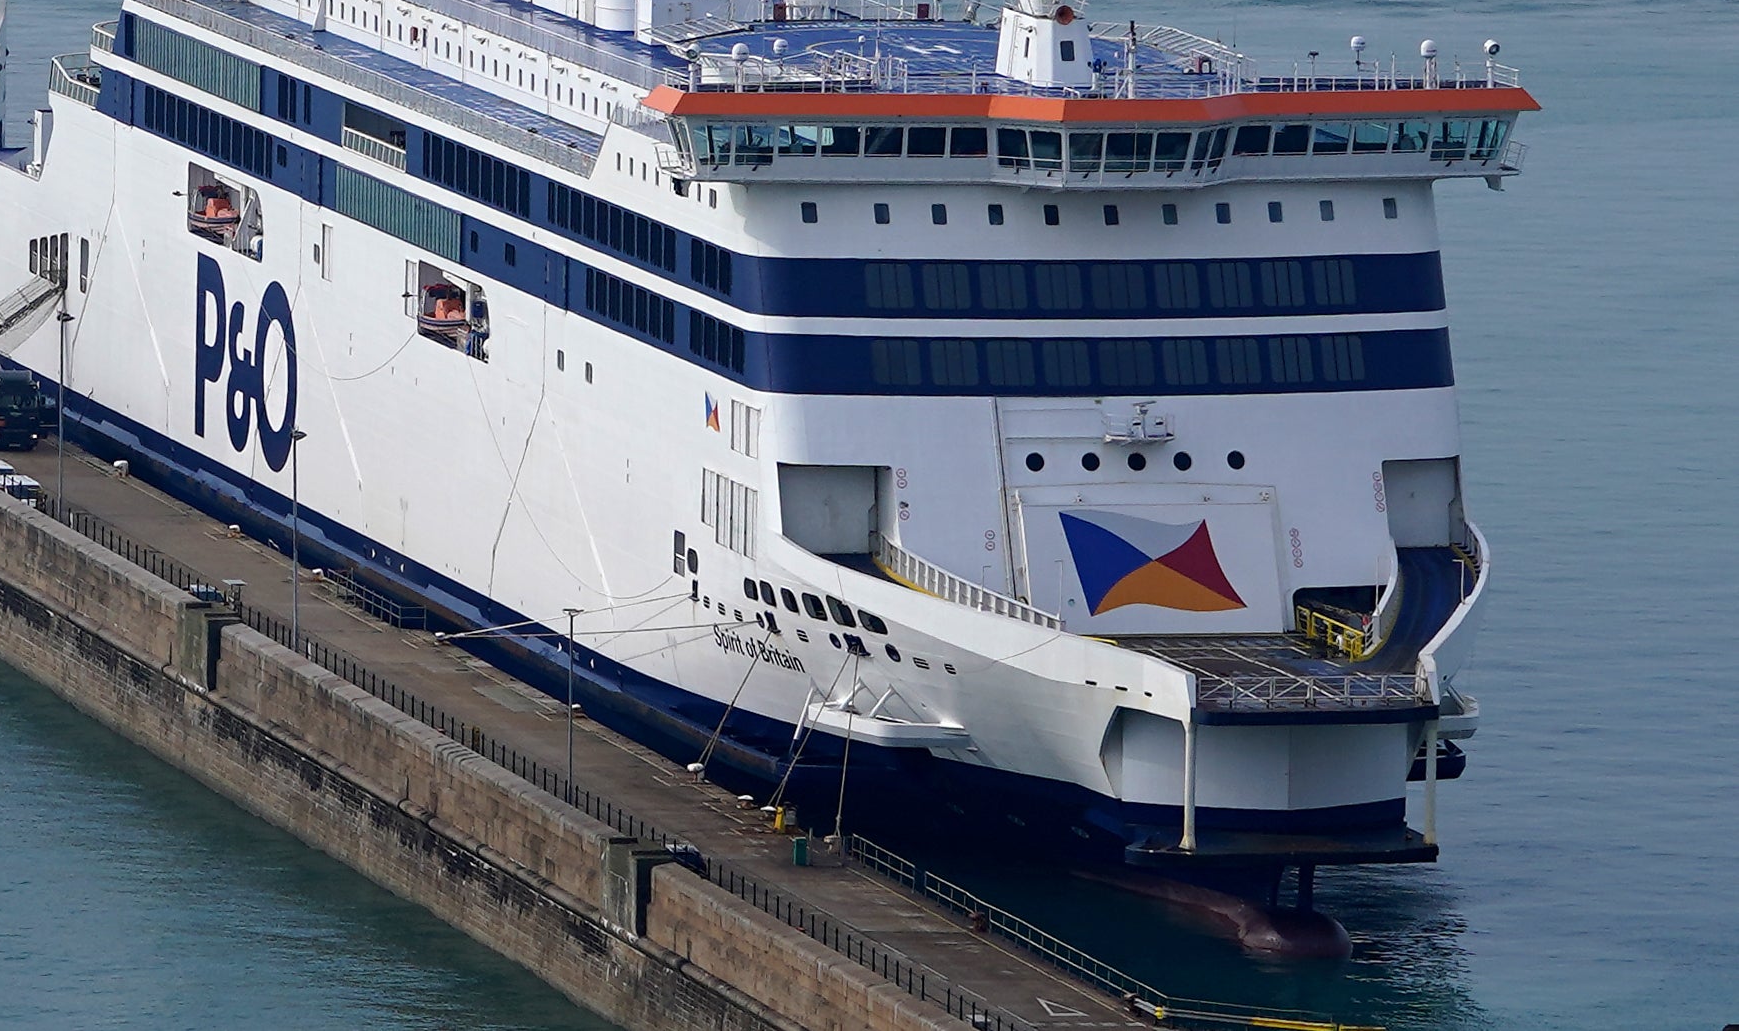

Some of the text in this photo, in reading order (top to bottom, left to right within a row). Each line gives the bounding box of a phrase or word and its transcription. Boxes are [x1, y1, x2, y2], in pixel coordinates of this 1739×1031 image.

[195, 251, 297, 473] P&O
[713, 624, 806, 673] Spirit of Britain
